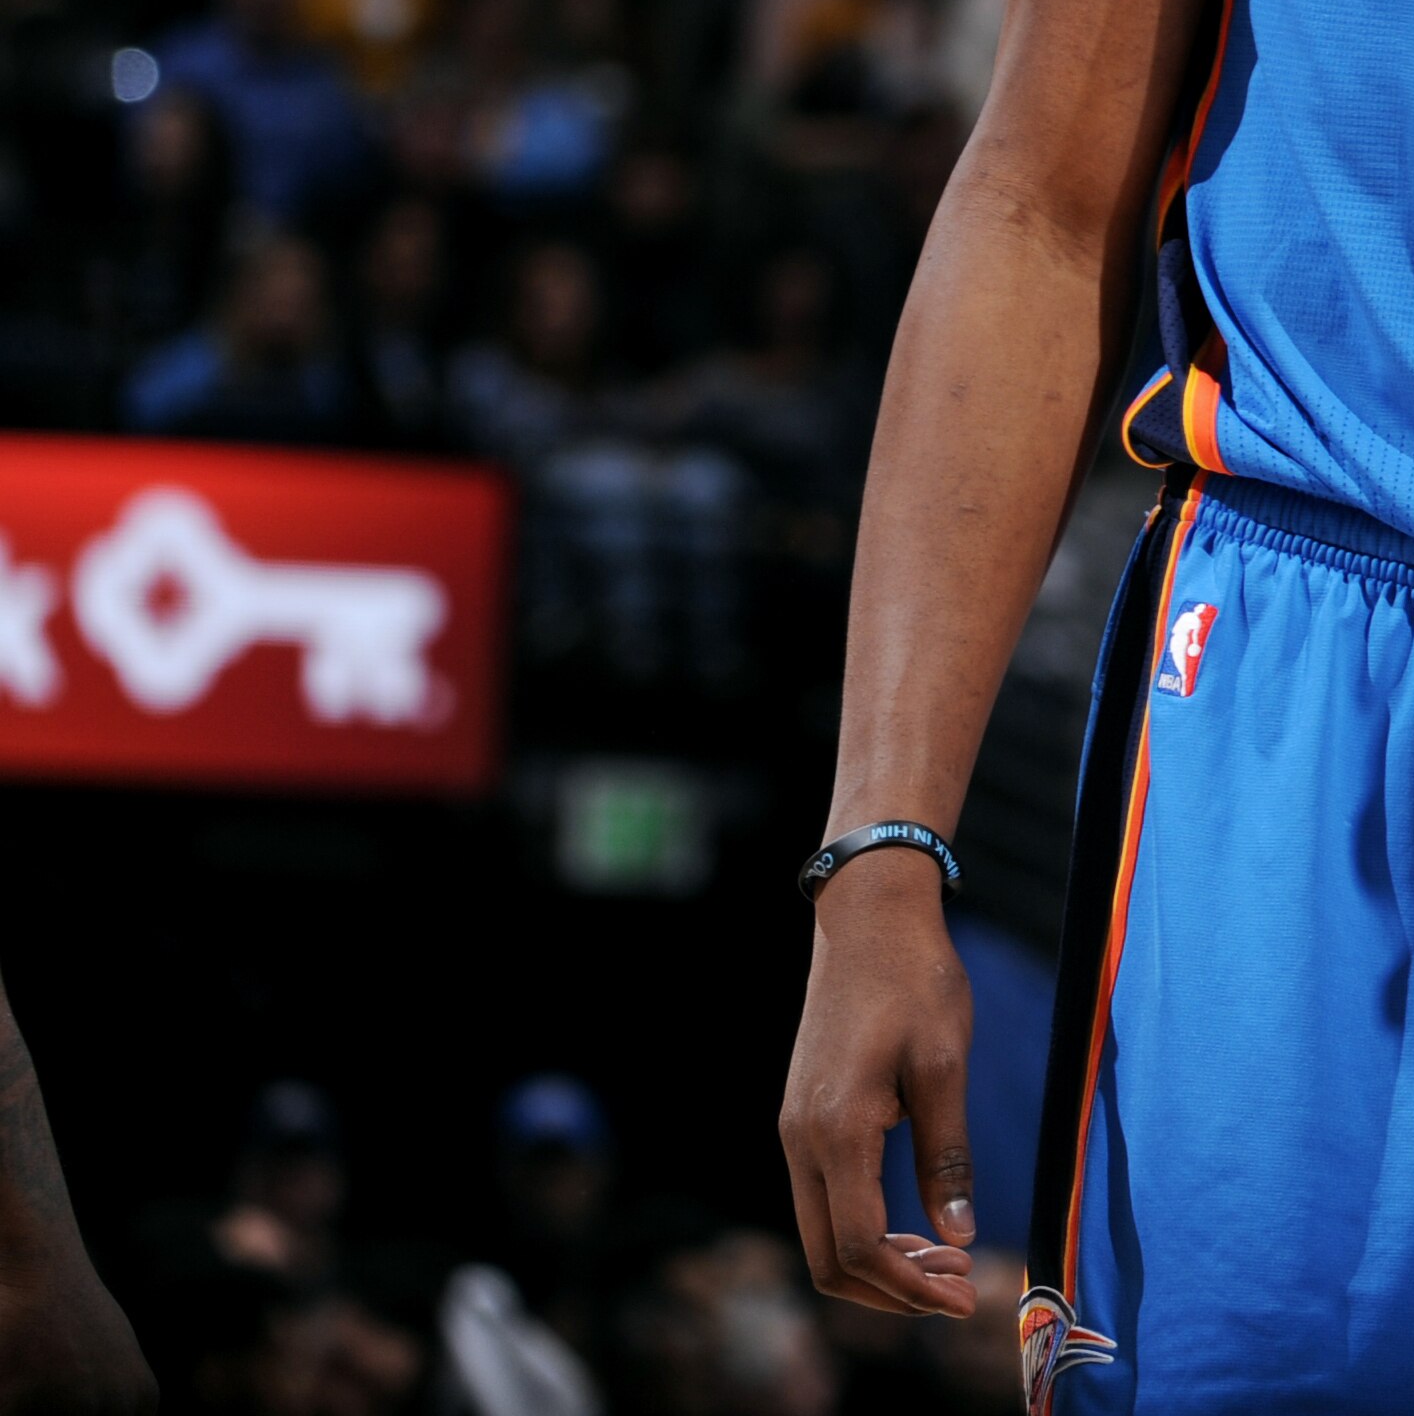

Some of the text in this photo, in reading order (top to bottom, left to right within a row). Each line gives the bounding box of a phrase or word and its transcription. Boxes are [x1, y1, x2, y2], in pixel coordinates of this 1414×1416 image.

[1158, 673, 1182, 692] NBA
[871, 824, 961, 879] WALK IN HIM
